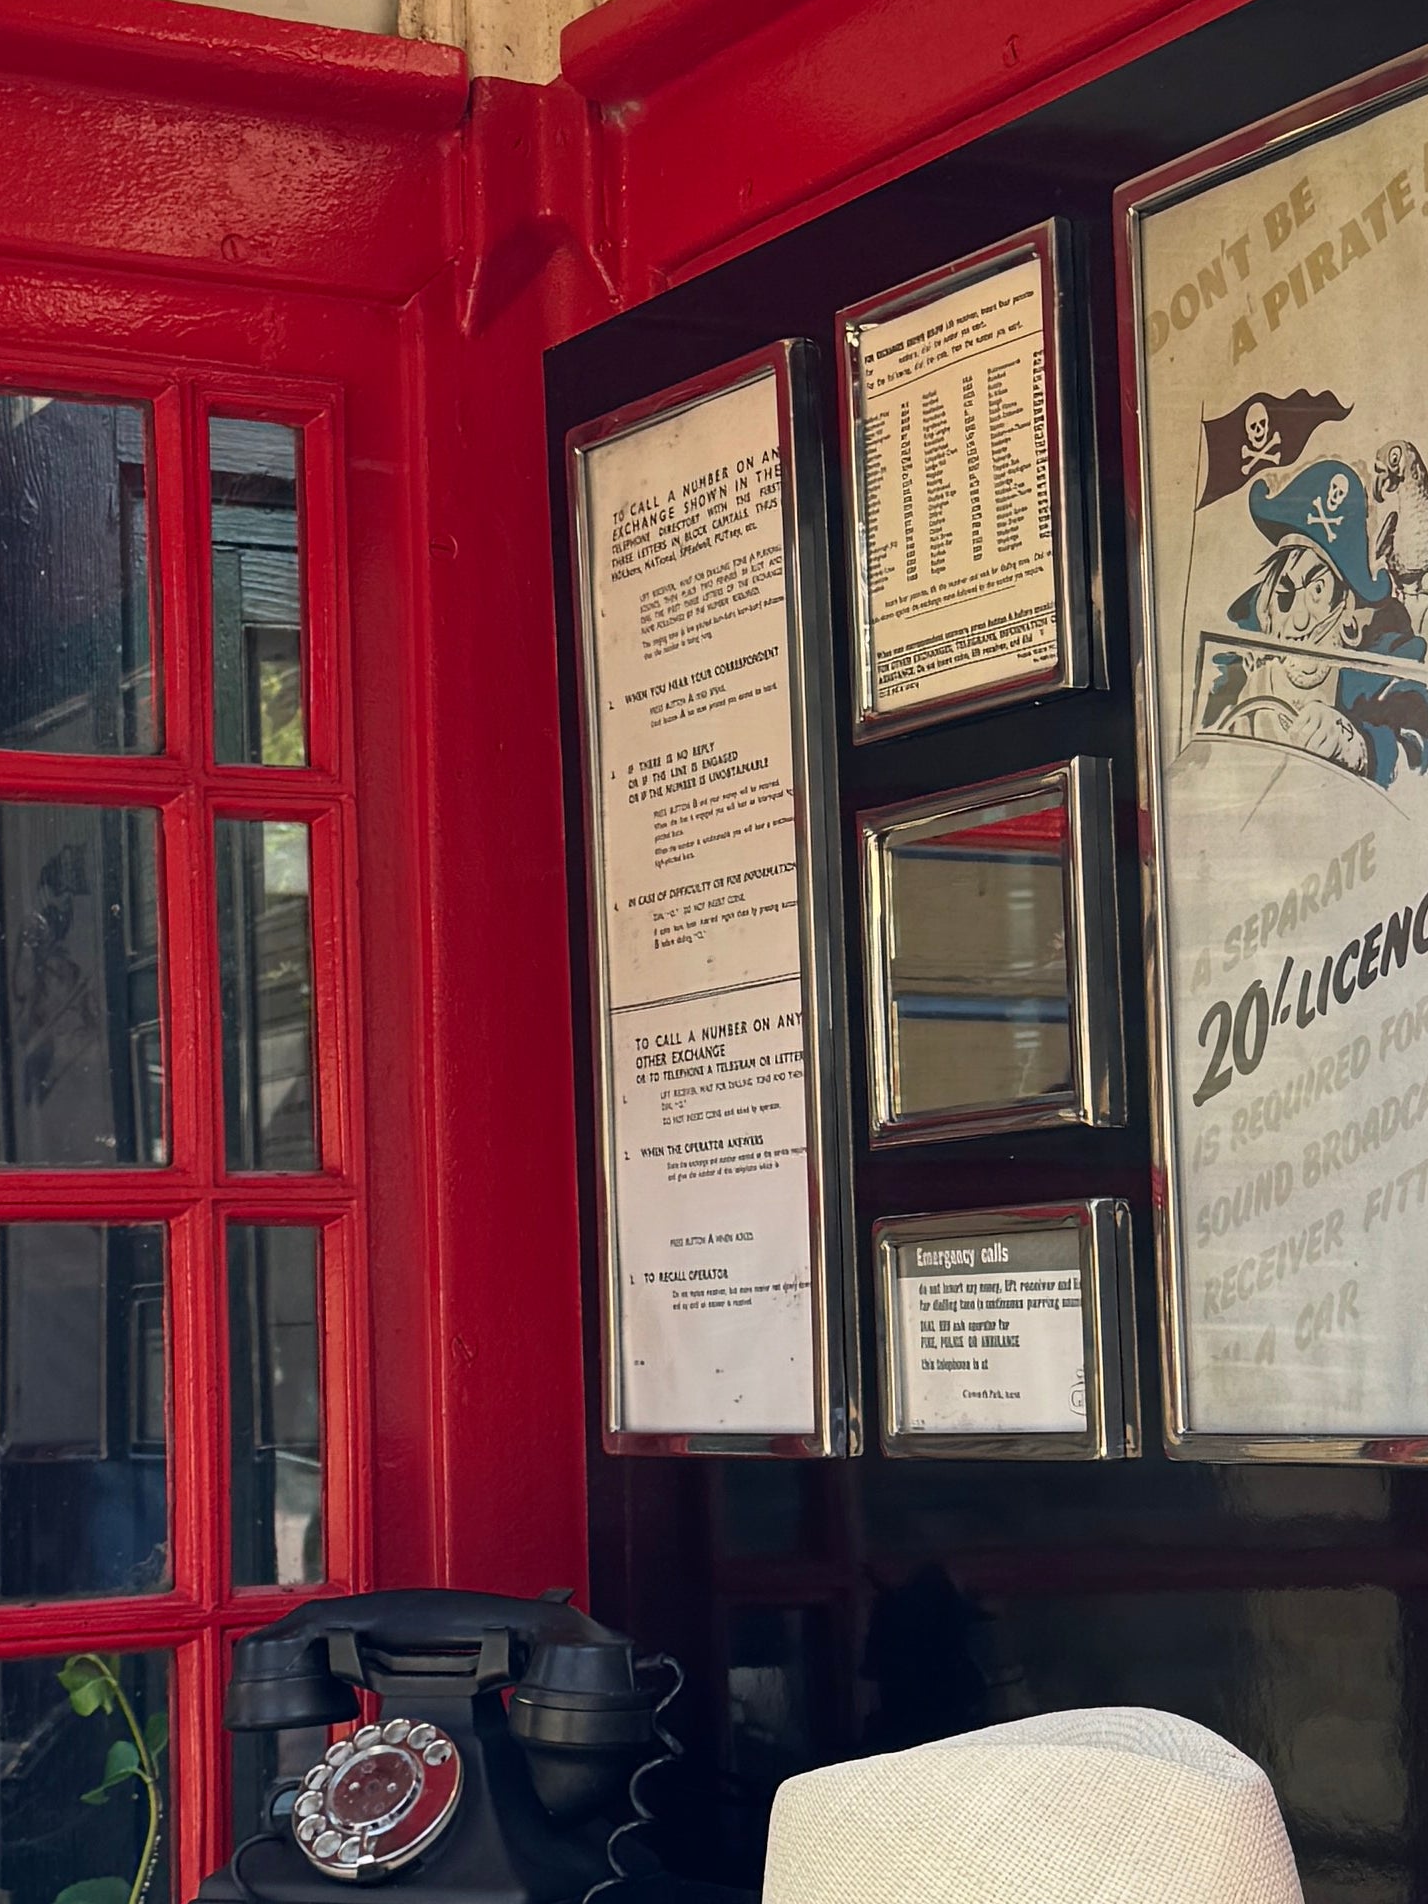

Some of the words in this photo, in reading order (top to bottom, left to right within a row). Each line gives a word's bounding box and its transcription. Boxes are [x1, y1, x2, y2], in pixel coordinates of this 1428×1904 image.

[1148, 233, 1251, 356] DON'T
[1263, 175, 1316, 252] BE
[1231, 315, 1258, 366] A
[613, 508, 624, 525] TO
[630, 496, 659, 516] CALL
[668, 490, 675, 502] A
[683, 467, 728, 496] NUMBER
[737, 456, 754, 473] ON
[613, 507, 674, 541] EXCHANGE
[684, 485, 727, 514] SHOWN
[735, 477, 747, 492] IN
[755, 461, 781, 482] THE
[1190, 948, 1211, 994] A
[1222, 831, 1376, 973] SEPARATE
[635, 1037, 649, 1051] TO
[655, 1033, 682, 1047] CALL
[688, 1030, 695, 1042] A
[702, 1021, 747, 1040] NUMBER
[753, 1017, 770, 1032] ON
[777, 1012, 801, 1028] ANY
[636, 1053, 666, 1069] OTHER
[672, 1044, 725, 1064] EXCHANGE
[1193, 1124, 1220, 1175] IS
[1230, 1034, 1371, 1151] REQUIRED
[641, 1147, 664, 1157] WHEN
[1195, 1160, 1294, 1249] SOUND
[644, 1272, 655, 1283] TO
[659, 1271, 686, 1282] RECALL
[917, 1248, 974, 1268] Emergency
[981, 1243, 1008, 1263] calls
[1202, 1208, 1345, 1320] RECEIVER
[1253, 1327, 1277, 1367] A
[1294, 1279, 1361, 1352] CAR
